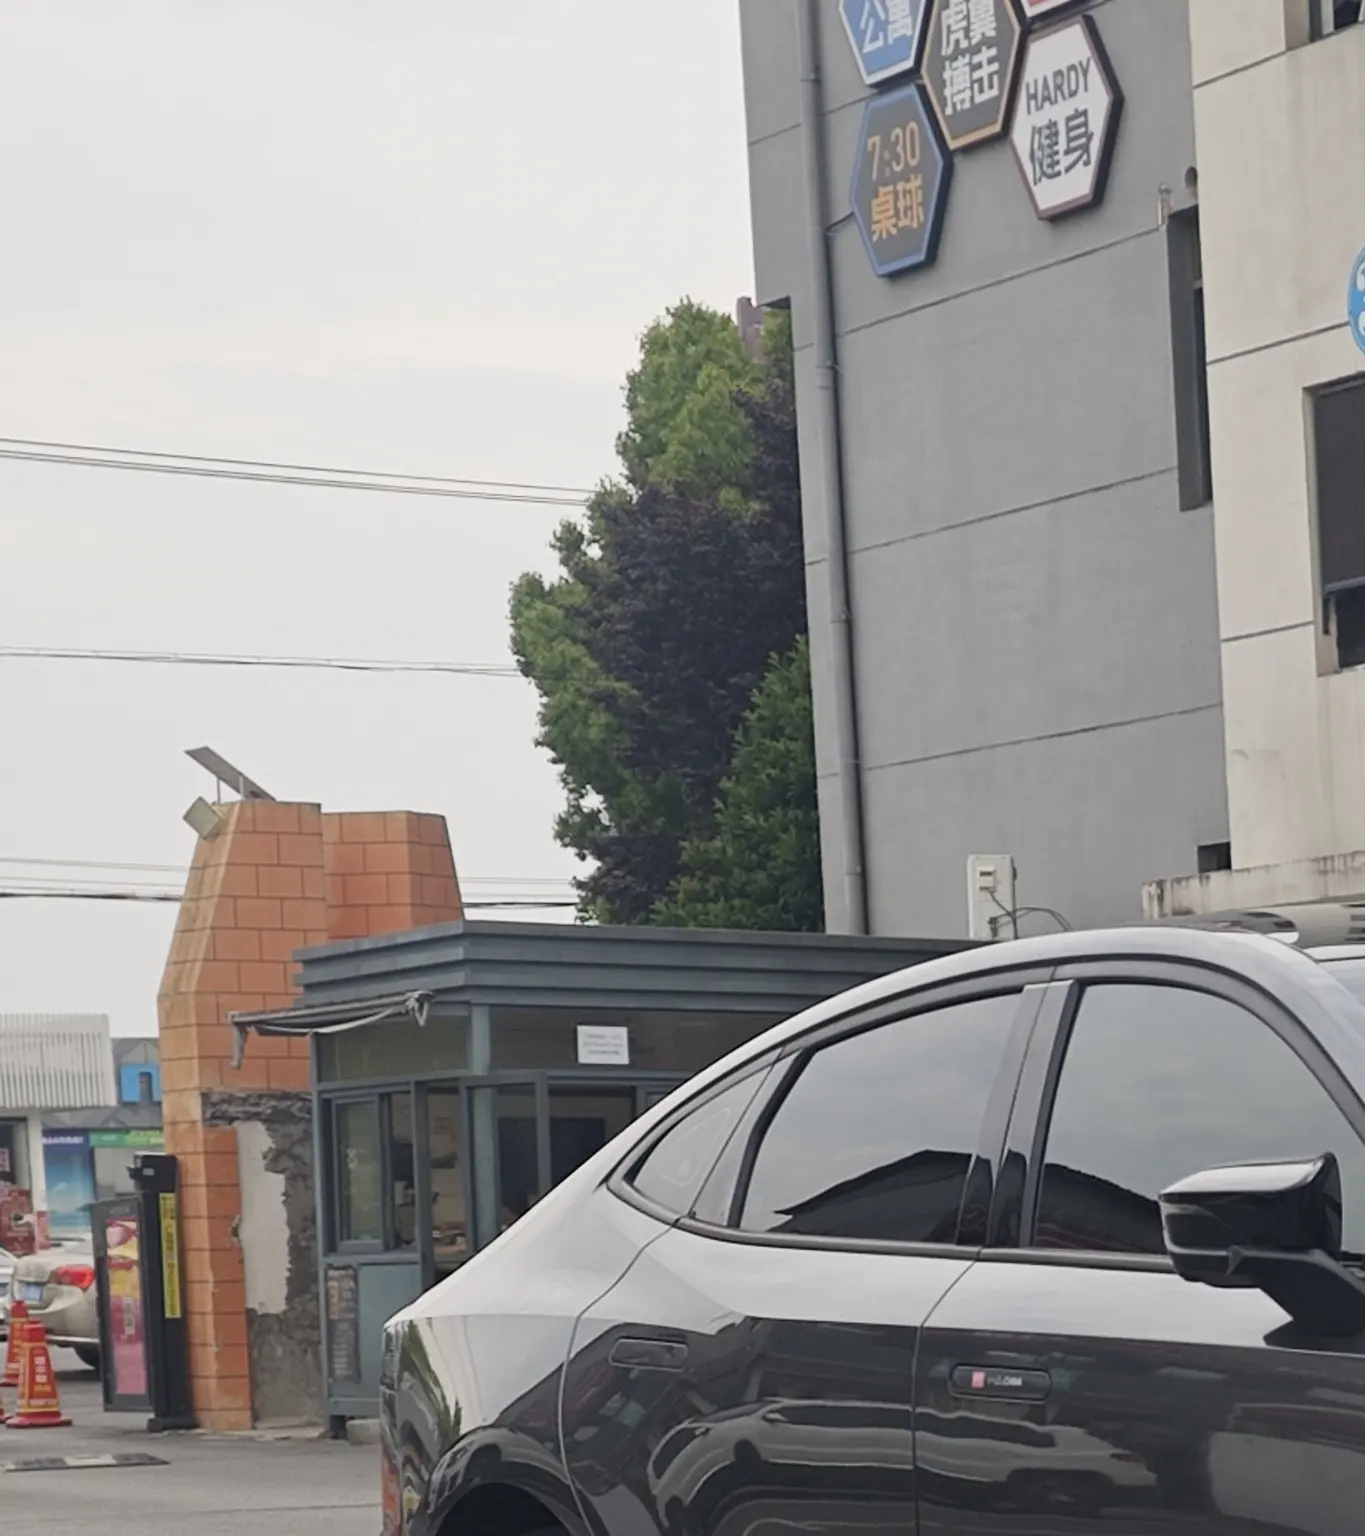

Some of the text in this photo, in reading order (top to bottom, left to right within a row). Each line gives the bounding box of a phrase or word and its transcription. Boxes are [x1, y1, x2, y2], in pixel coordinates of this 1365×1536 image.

[942, 46, 999, 116] 搏击
[1025, 56, 1092, 115] HARDY
[868, 121, 920, 181] 7:30
[1030, 107, 1094, 187] 健身
[871, 173, 924, 242] 桌球
